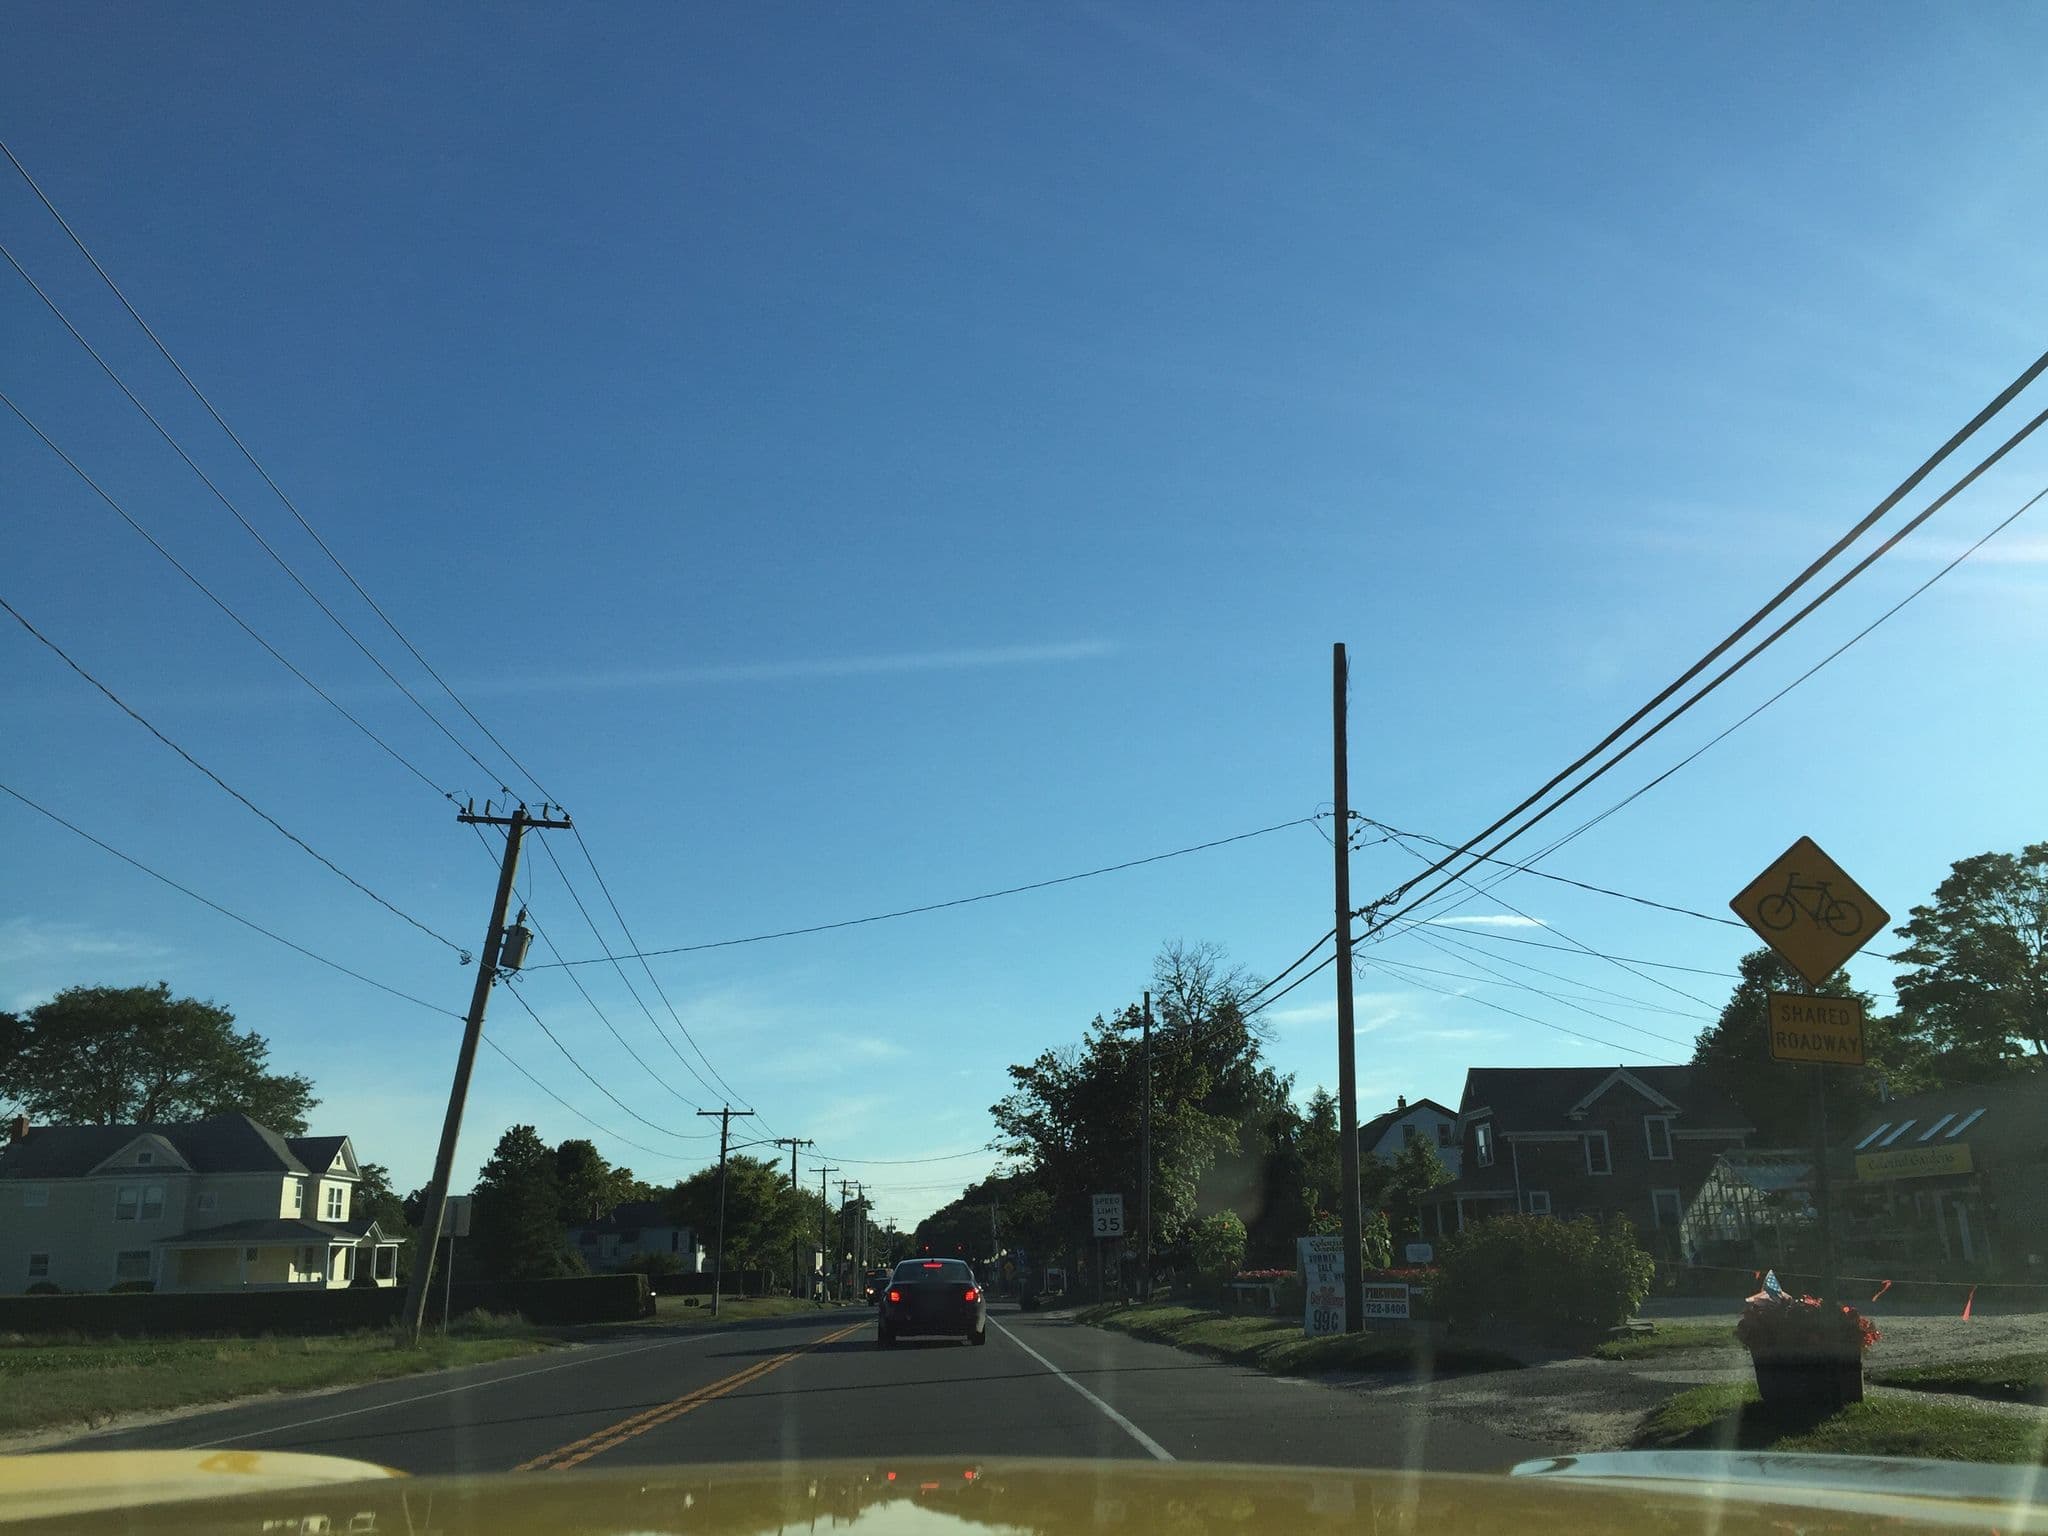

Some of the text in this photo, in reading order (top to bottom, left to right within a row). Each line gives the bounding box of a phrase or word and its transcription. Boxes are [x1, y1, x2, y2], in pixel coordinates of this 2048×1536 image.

[1781, 1005, 1850, 1025] SHARED
[1775, 1031, 1858, 1052] ROADWAY
[1097, 1207, 1118, 1215] LIMIT
[1097, 1217, 1120, 1232] 35
